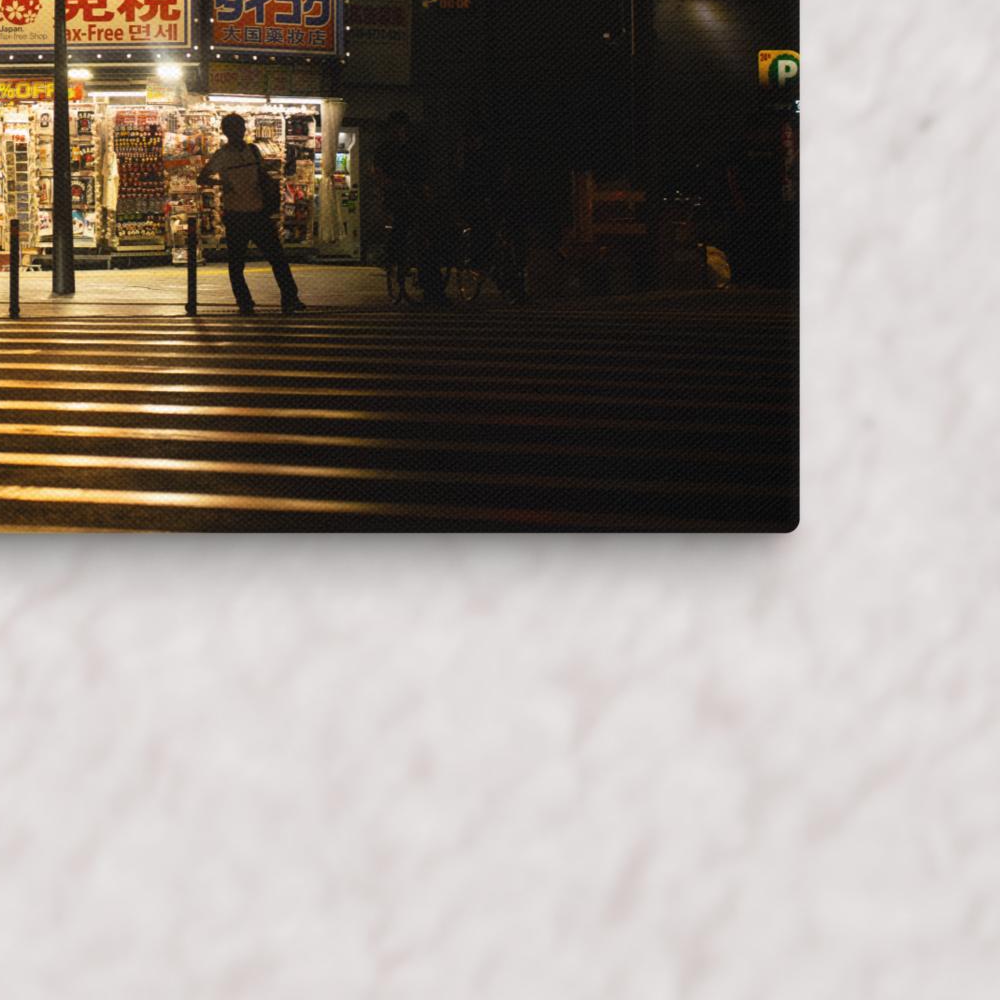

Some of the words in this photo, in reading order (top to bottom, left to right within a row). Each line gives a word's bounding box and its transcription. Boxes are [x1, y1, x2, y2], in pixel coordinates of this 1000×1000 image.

[64, 24, 124, 42] ax-Free
[128, 23, 178, 41] 면세
[777, 59, 798, 88] P
